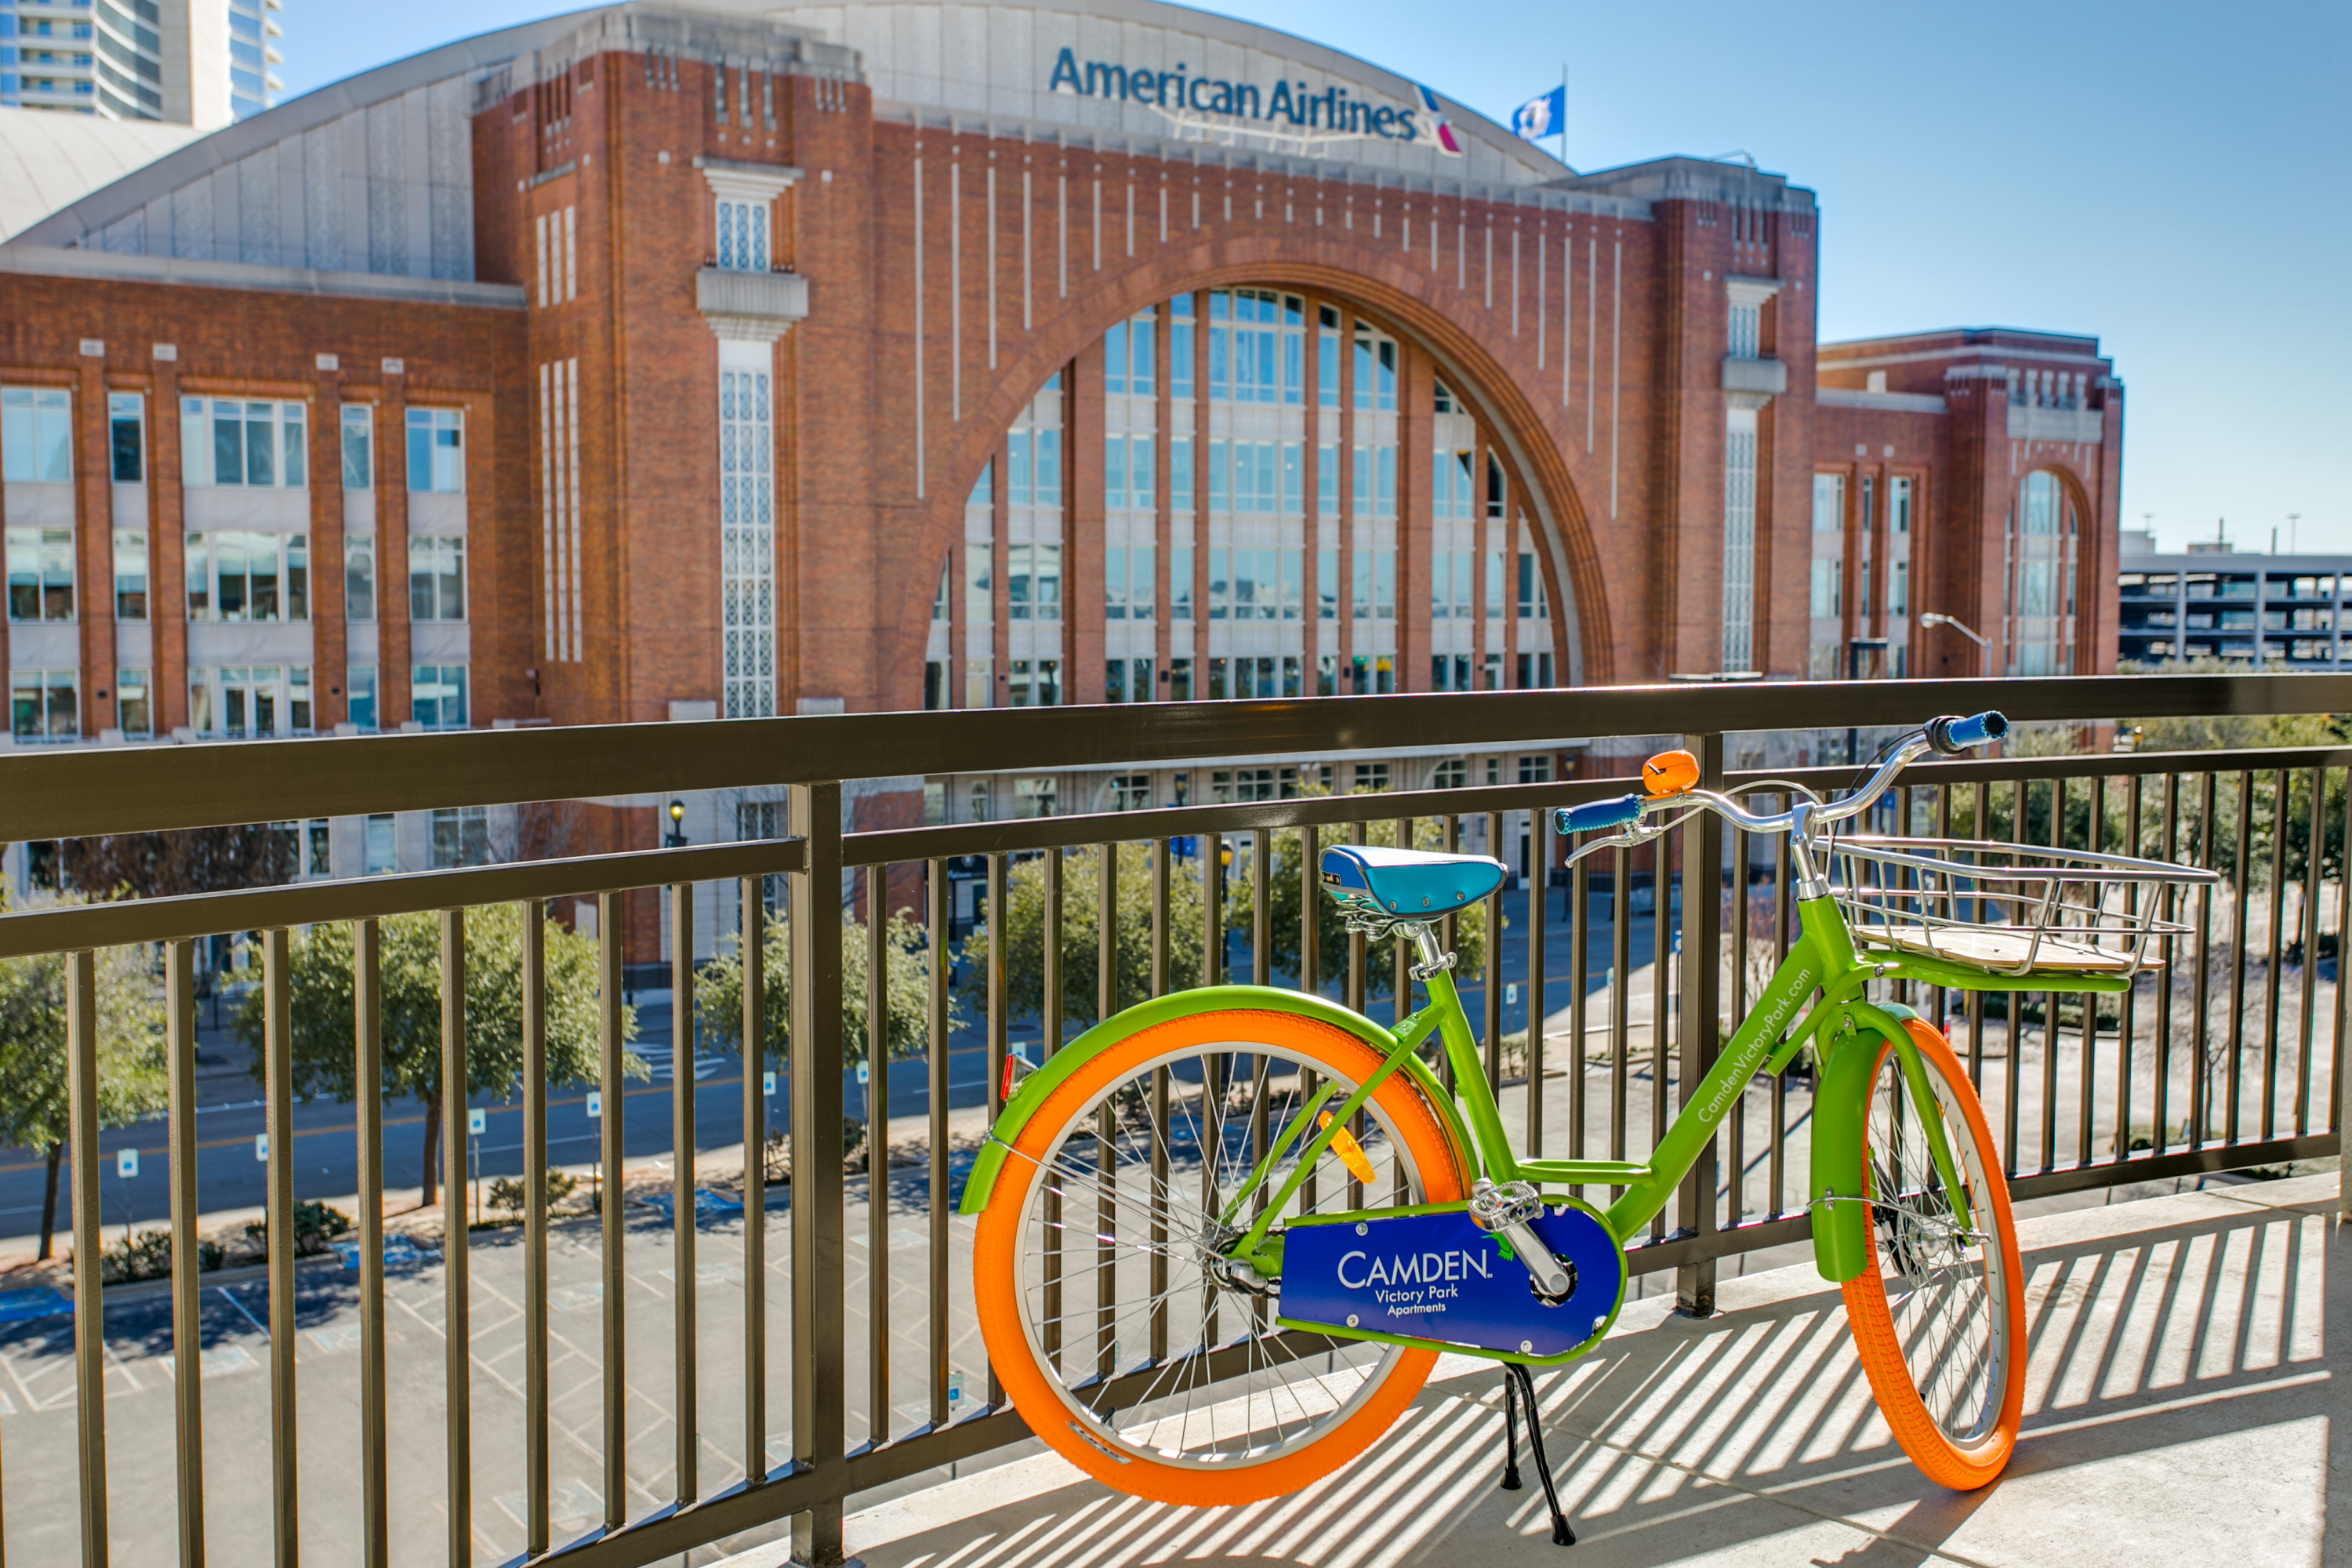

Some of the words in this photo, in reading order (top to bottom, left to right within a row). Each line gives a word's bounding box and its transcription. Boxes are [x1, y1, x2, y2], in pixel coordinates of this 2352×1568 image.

[1049, 46, 1261, 118] American
[1267, 79, 1417, 141] Airlines
[1337, 1249, 1487, 1288] CAMDEN
[1374, 1289, 1424, 1304] Victory
[1428, 1283, 1458, 1299] Park
[1387, 1301, 1446, 1318] Apartments
